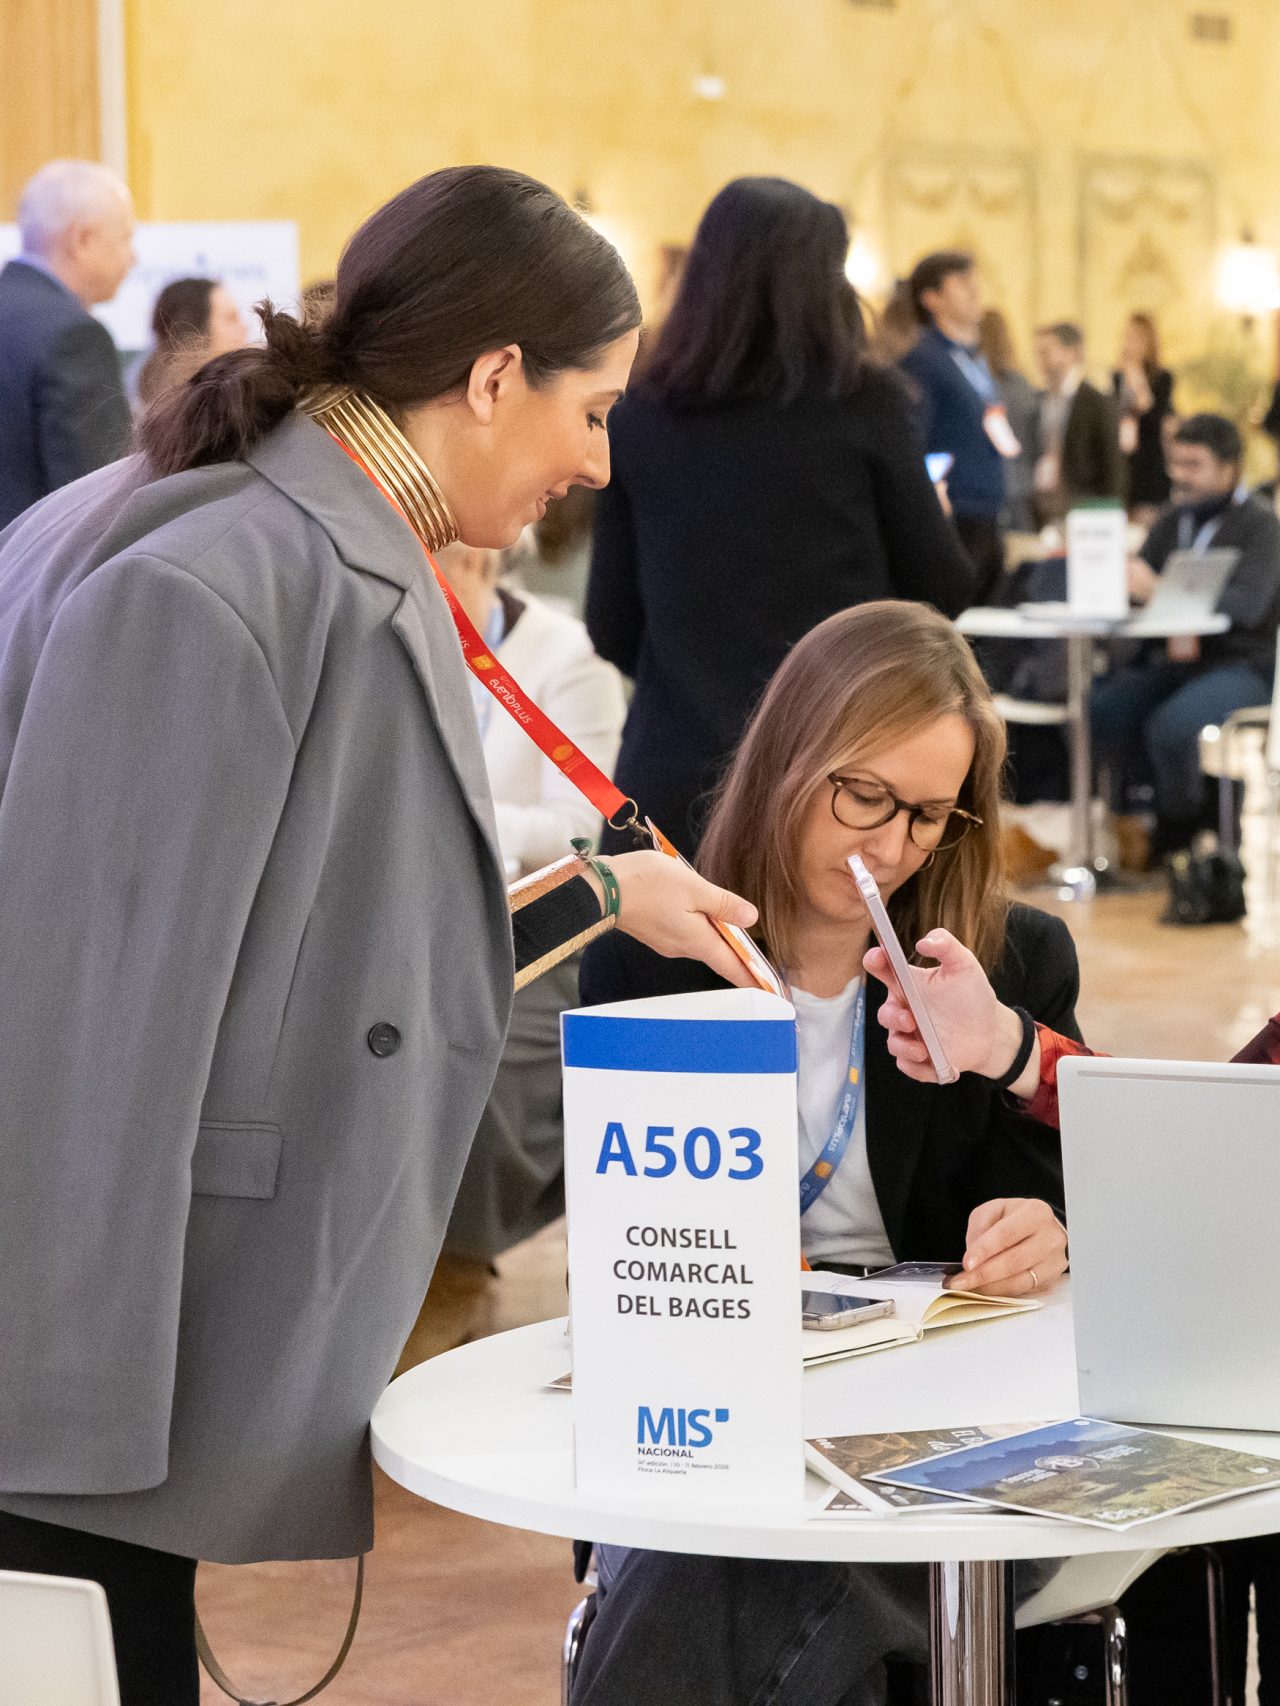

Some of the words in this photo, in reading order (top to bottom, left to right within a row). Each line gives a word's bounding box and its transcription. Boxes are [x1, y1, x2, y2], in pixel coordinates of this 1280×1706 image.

[596, 1122, 764, 1180] A503
[626, 1226, 737, 1250] CONSELL
[613, 1259, 753, 1284] COMARCAL
[617, 1294, 662, 1316] DEL
[668, 1297, 751, 1319] BAGES
[637, 1406, 713, 1448] MIS
[637, 1447, 694, 1458] NACIONAL
